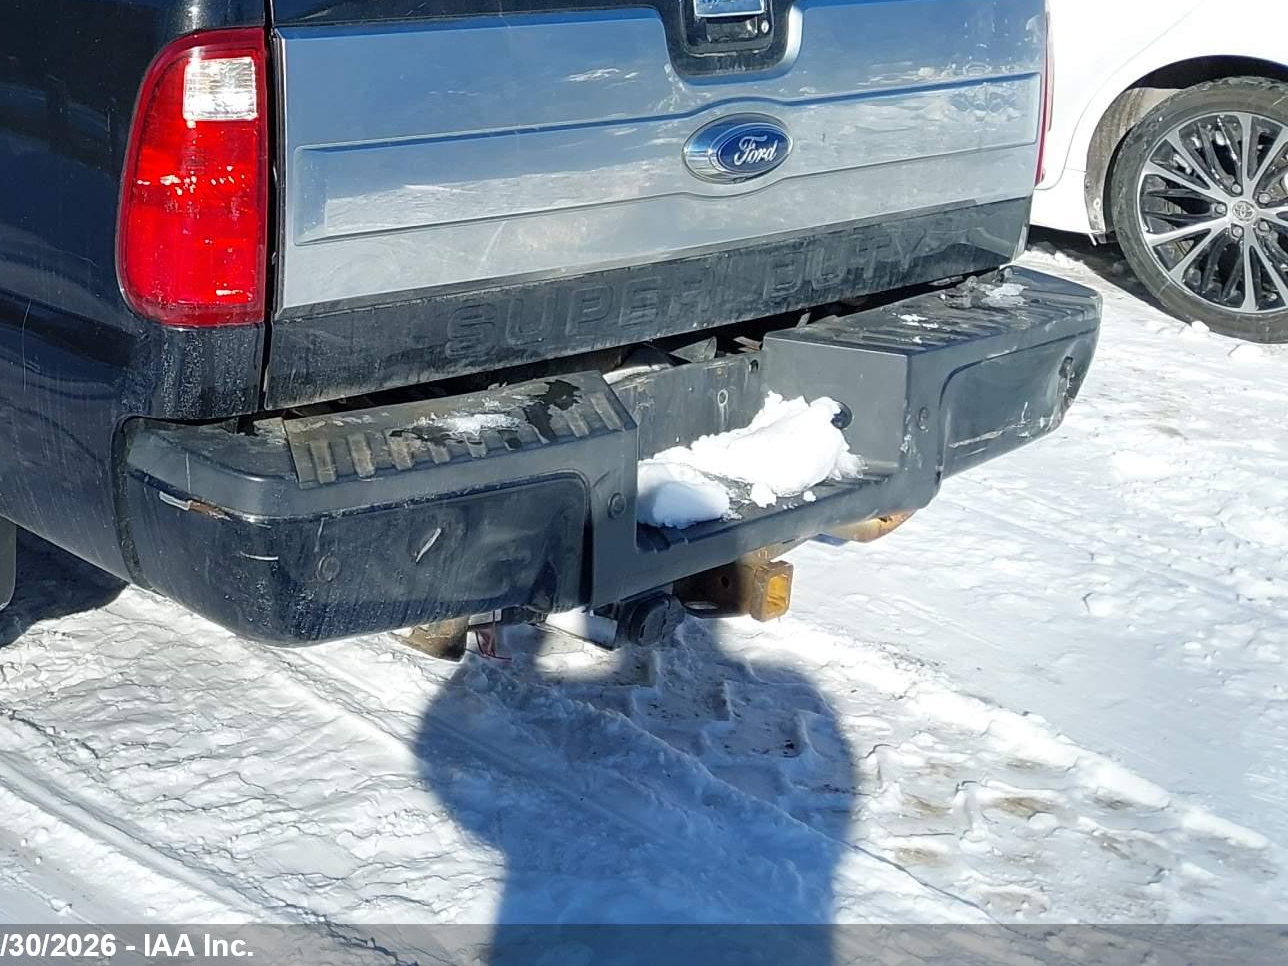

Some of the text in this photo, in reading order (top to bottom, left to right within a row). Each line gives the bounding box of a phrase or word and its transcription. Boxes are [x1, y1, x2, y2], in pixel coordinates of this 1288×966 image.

[733, 135, 778, 166] Ford
[445, 226, 928, 359] SUPER DUTY
